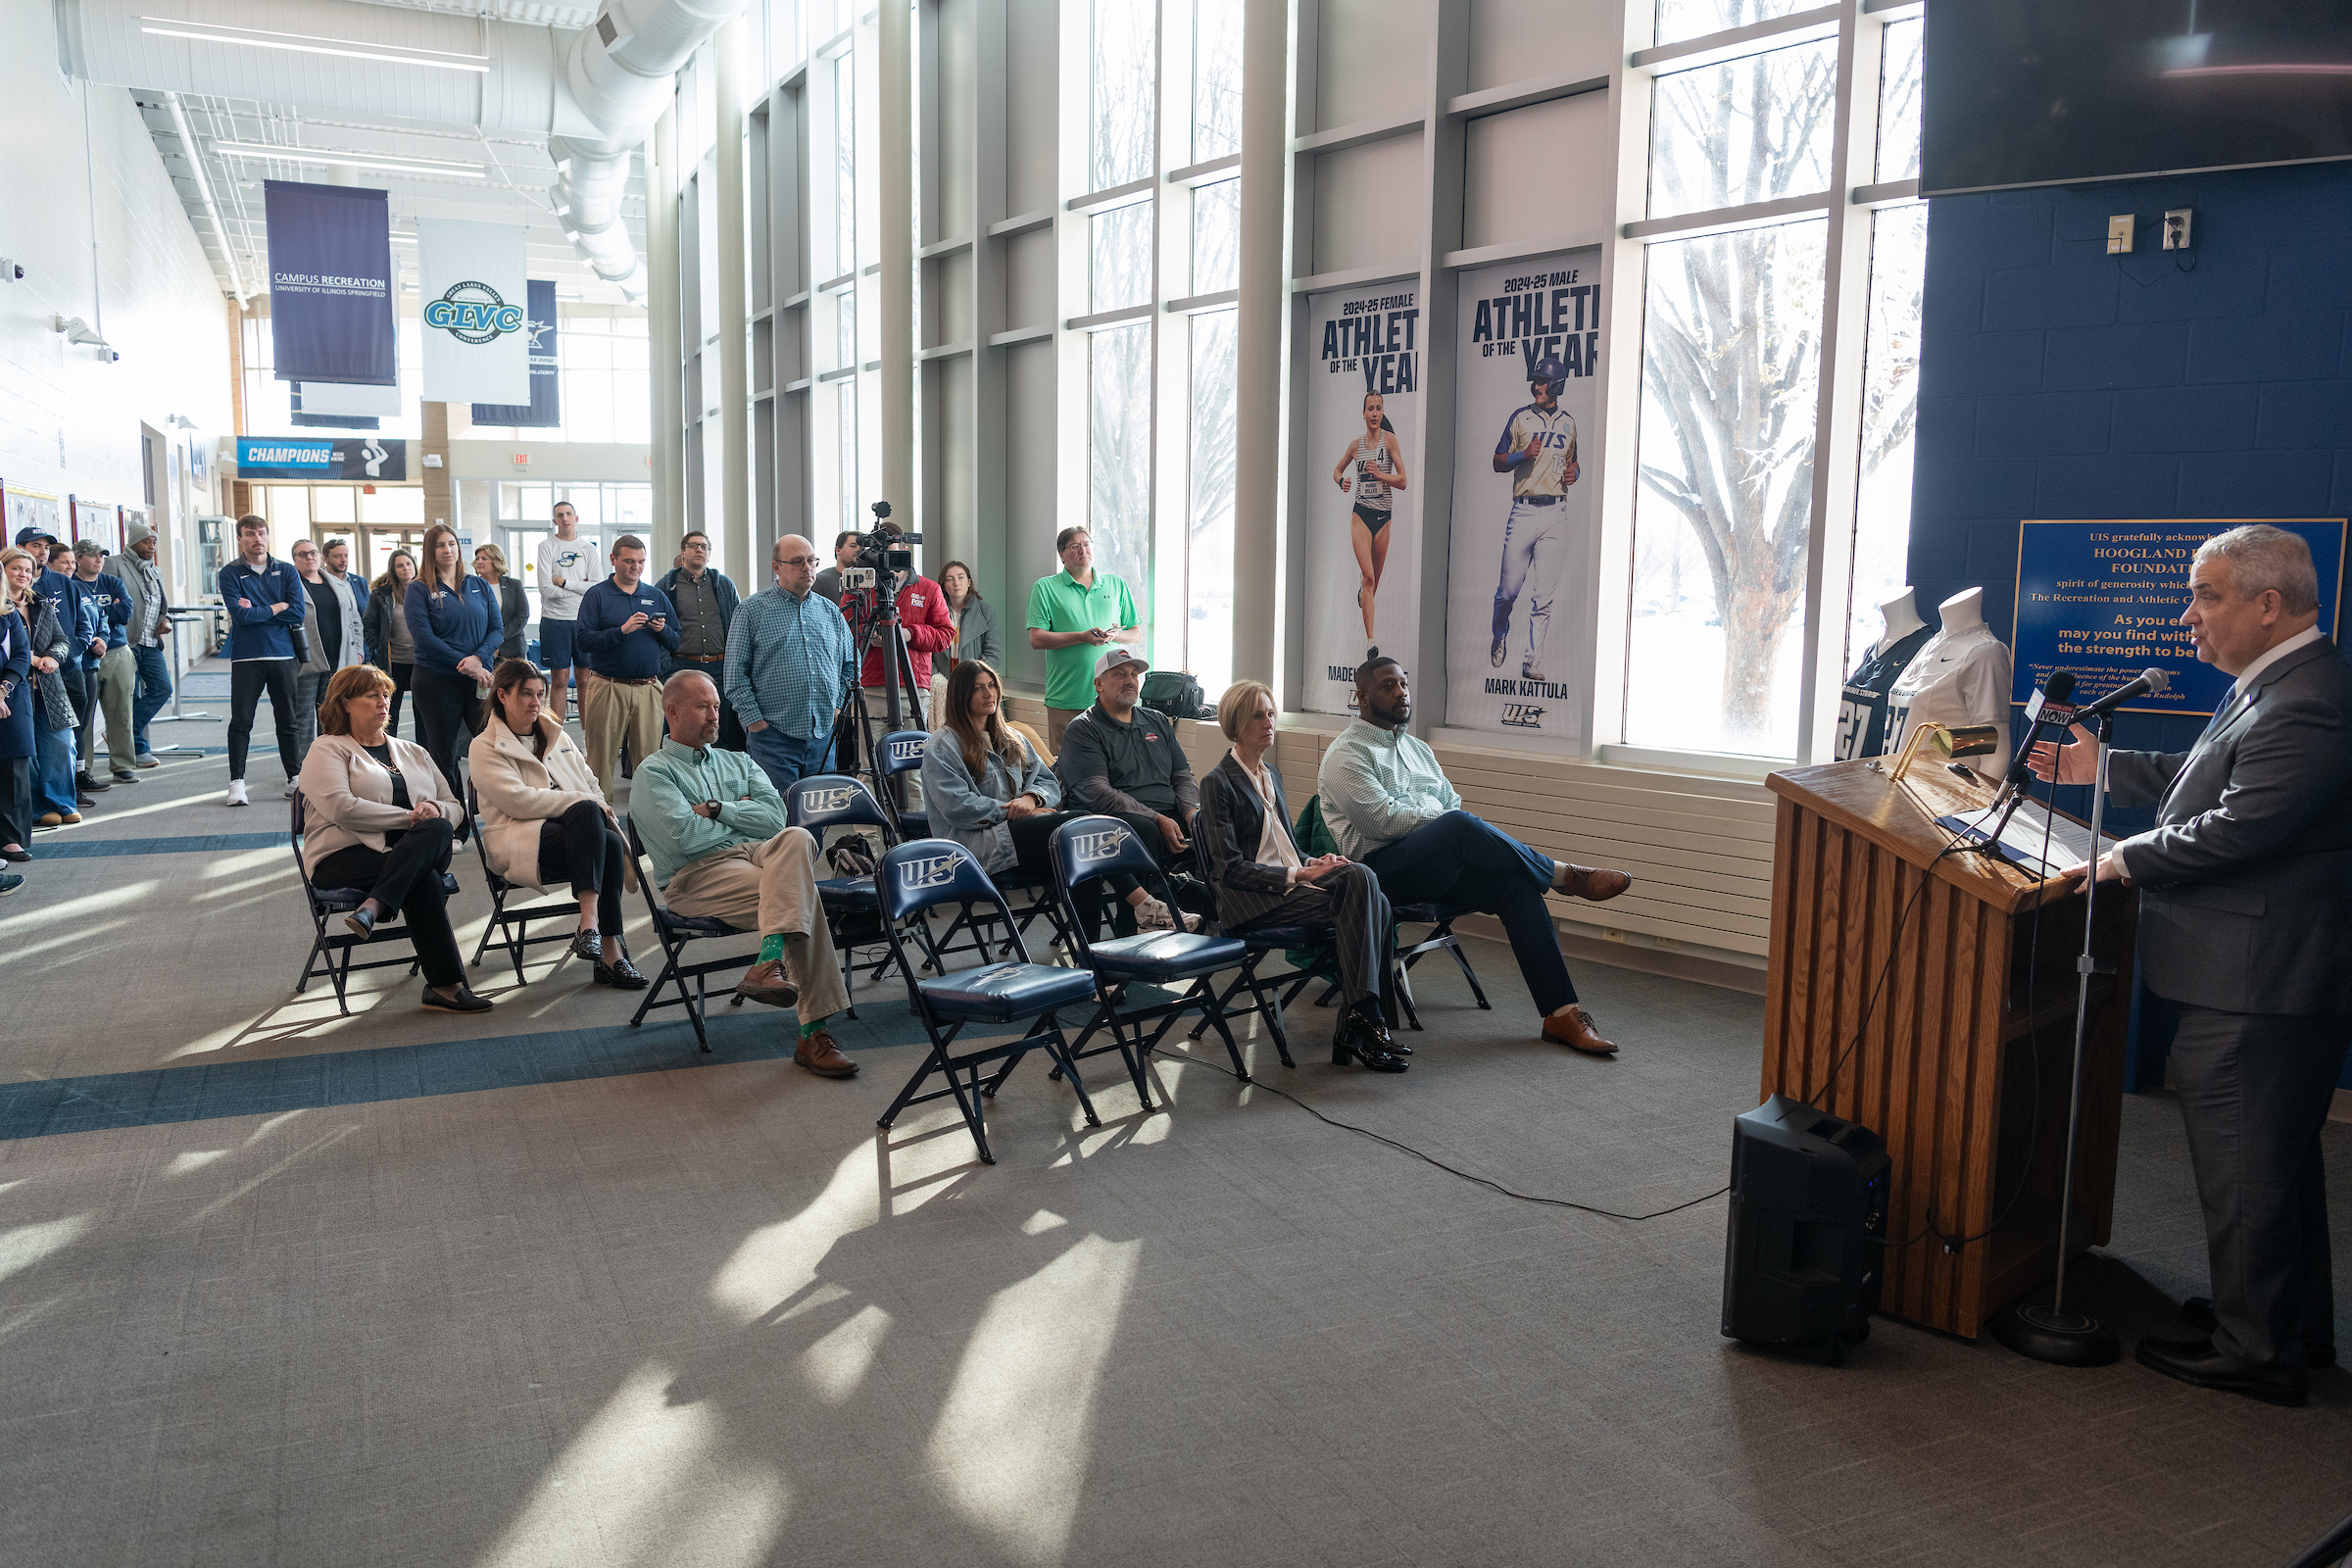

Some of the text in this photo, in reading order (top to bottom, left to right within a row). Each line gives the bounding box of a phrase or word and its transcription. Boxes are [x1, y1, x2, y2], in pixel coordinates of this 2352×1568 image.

[274, 272, 386, 288] CAMPUS RECREATION
[1504, 270, 1579, 293] 2024-25 MALE
[347, 289, 386, 298] SPRINGFIELD
[446, 284, 462, 298] GREAT
[482, 284, 501, 302] VALLEY
[1344, 293, 1413, 316] 2024-25 FEMALE
[424, 300, 523, 333] GLVC
[456, 332, 494, 344] CONFERENCE
[1483, 343, 1494, 358] OF
[1497, 340, 1515, 356] THE
[1330, 361, 1341, 373] OF
[1343, 359, 1357, 372] THE
[248, 448, 330, 464] CHAMPIONS
[515, 454, 527, 464] EXIT
[1378, 448, 1384, 464] 4
[2089, 532, 2110, 541] UIS
[2112, 532, 2162, 544] gratefully
[2094, 548, 2186, 559] HOOGLAND
[2057, 579, 2085, 589] spirit
[2088, 579, 2100, 588] of
[2101, 580, 2157, 591] generosity
[911, 598, 924, 607] FOX
[2031, 593, 2050, 602] The
[2053, 594, 2109, 603] Recreation
[2136, 596, 2180, 605] Athletic
[2114, 614, 2132, 625] As
[2136, 616, 2165, 627] you
[2059, 629, 2090, 641] may
[2094, 630, 2122, 641] you
[2126, 629, 2156, 641] find
[2058, 643, 2195, 658] the strength to be
[1485, 678, 1568, 699] MARK KATTULA
[1502, 704, 1542, 723] UIS
[2039, 710, 2070, 723] NOW
[890, 740, 926, 760] UIS
[802, 786, 858, 813] UIS
[1071, 828, 1126, 861] UIS
[898, 852, 962, 890] UIS
